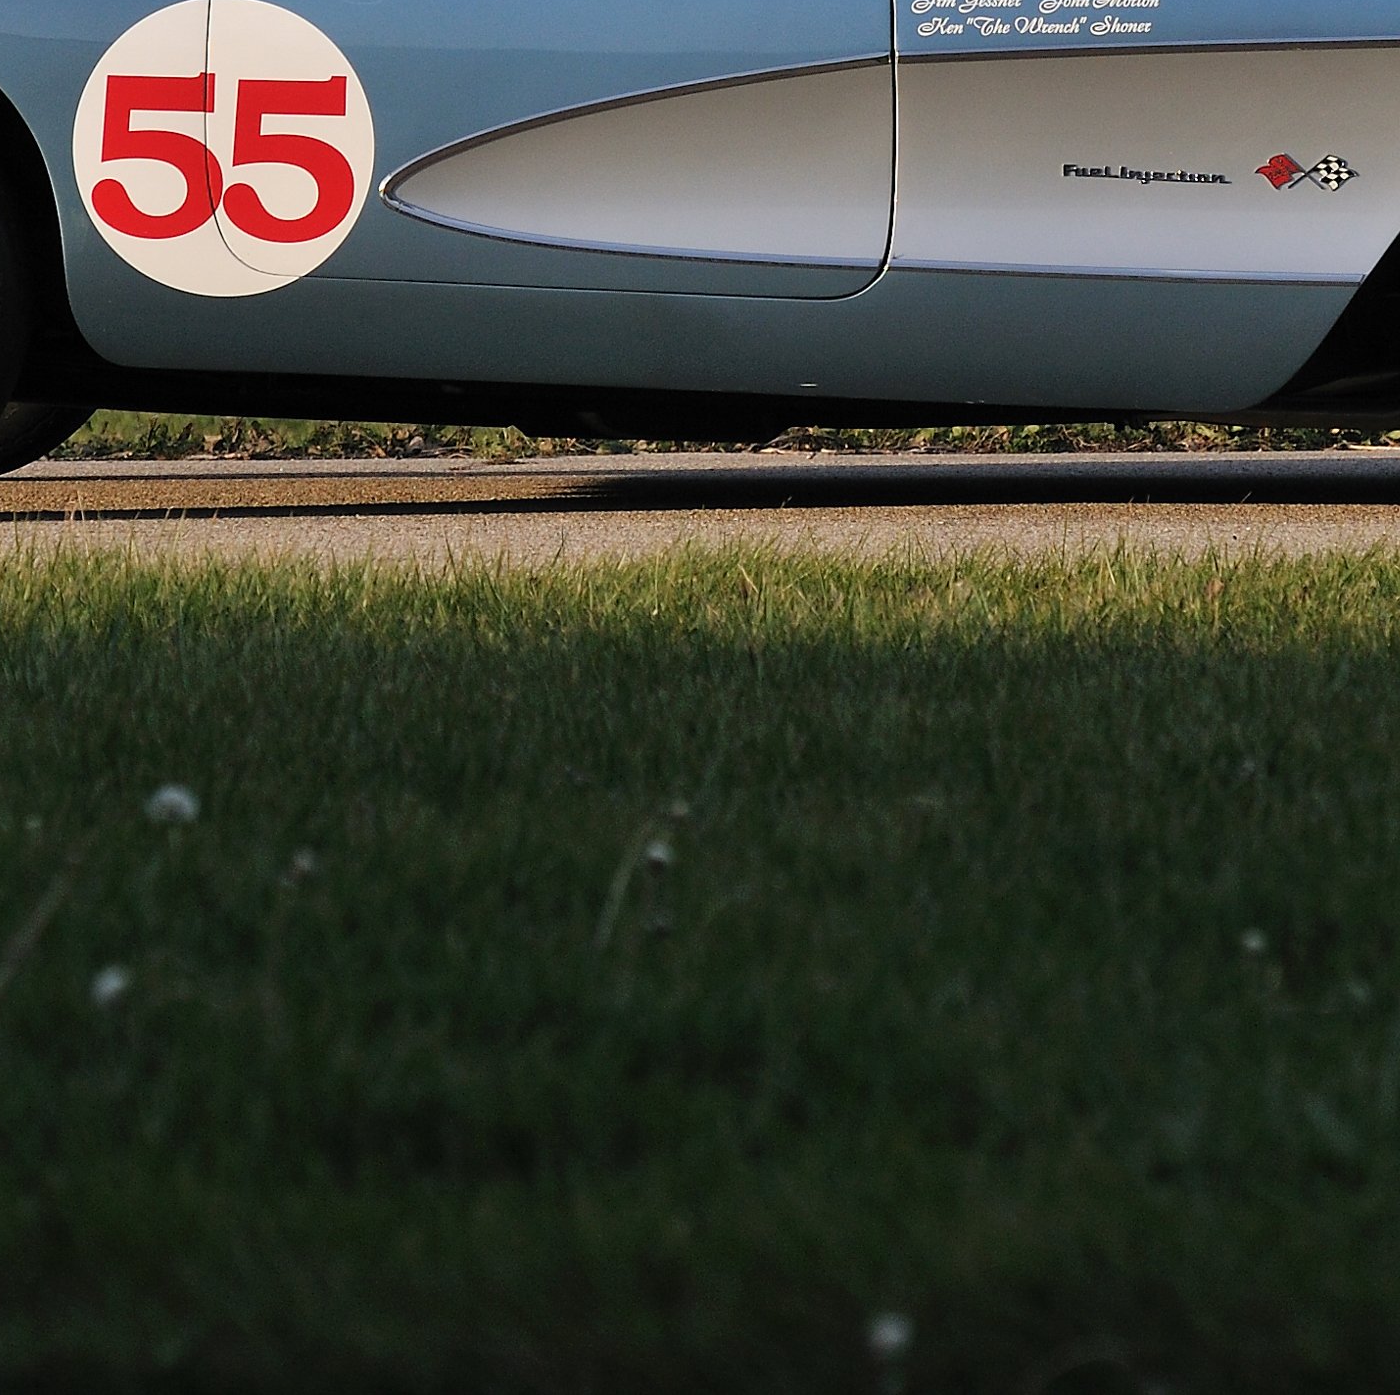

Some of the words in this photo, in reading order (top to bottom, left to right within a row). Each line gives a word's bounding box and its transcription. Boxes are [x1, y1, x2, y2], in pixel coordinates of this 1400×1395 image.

[917, 17, 964, 37] Ken
[966, 16, 1011, 37] "The
[1015, 16, 1087, 35] Wrench"
[1090, 16, 1152, 36] Shoner
[91, 72, 355, 243] 55
[1062, 163, 1119, 179] Fuel
[1119, 166, 1232, 185] Injection
